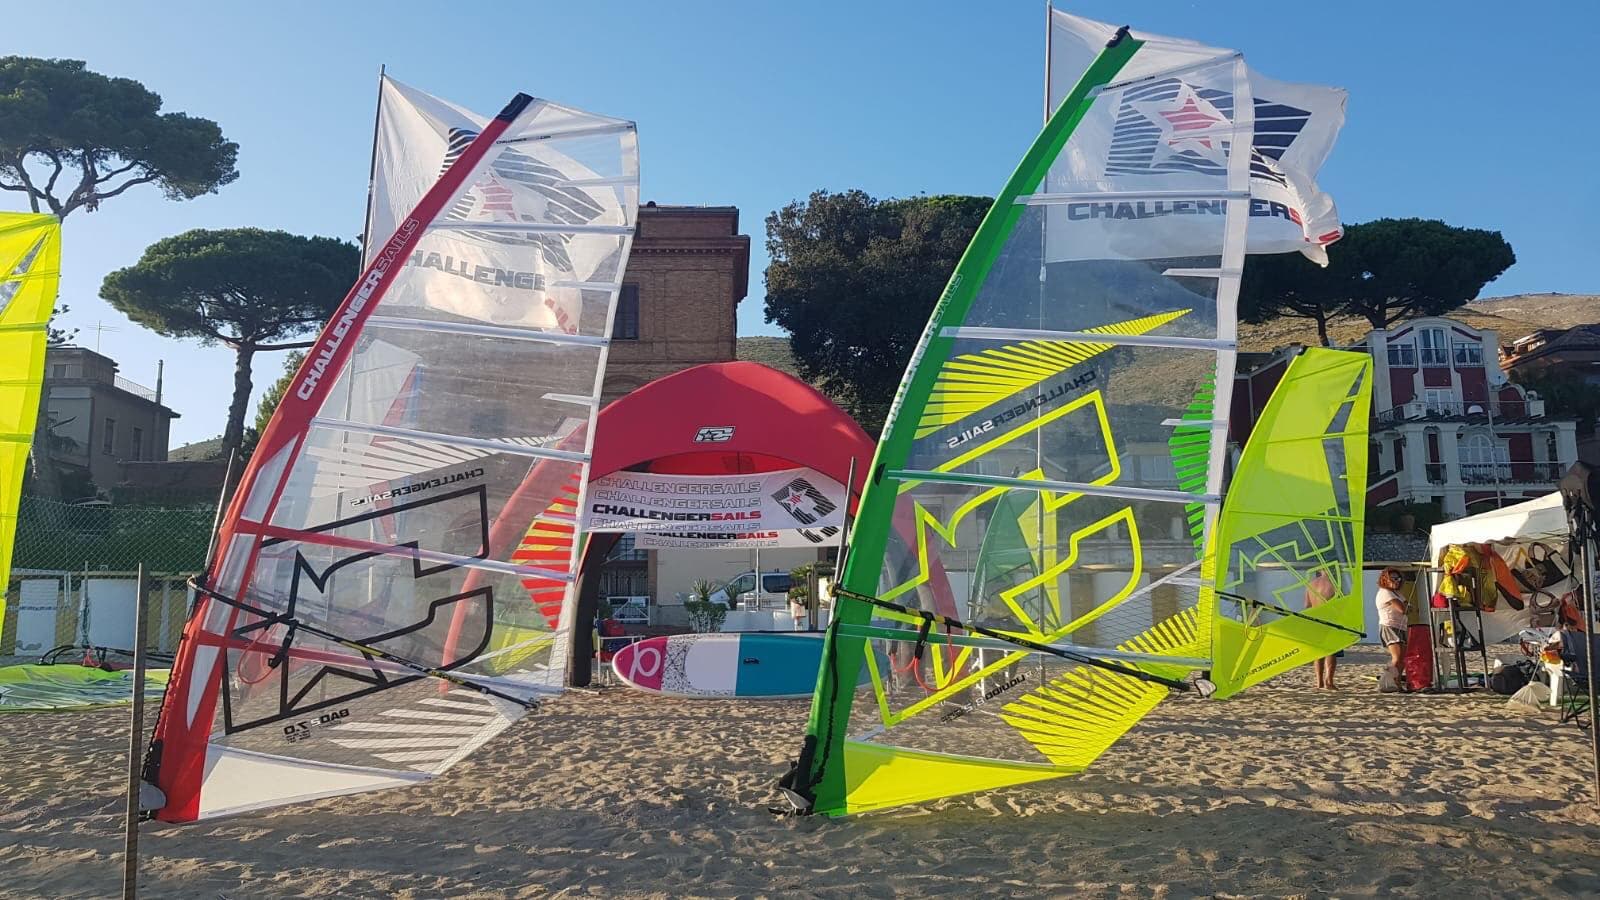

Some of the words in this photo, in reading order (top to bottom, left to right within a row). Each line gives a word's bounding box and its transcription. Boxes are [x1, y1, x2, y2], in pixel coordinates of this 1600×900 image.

[404, 249, 546, 292] HALLENGE
[297, 217, 420, 401] CHALLENGERSAILS
[597, 477, 761, 495] CHALLENGERSAILS
[594, 489, 761, 509] CHALLENGERSAILS
[592, 503, 762, 521] CHALLENGERSAILS
